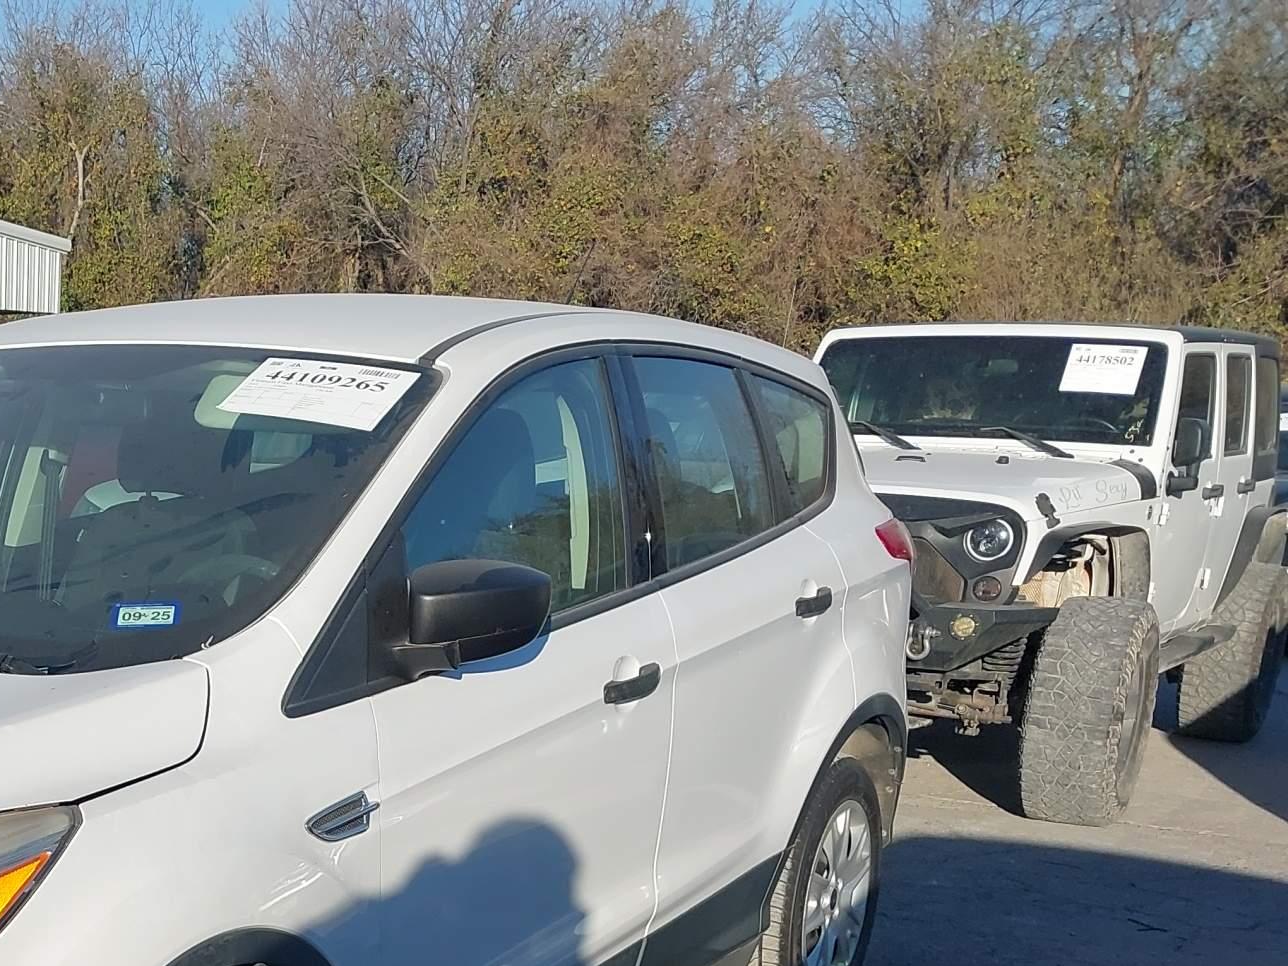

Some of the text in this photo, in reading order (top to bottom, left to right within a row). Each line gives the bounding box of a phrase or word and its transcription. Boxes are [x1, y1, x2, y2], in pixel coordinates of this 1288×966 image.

[1076, 354, 1135, 366] 44178502
[266, 370, 389, 392] 44109265
[121, 610, 171, 621] 09 25
